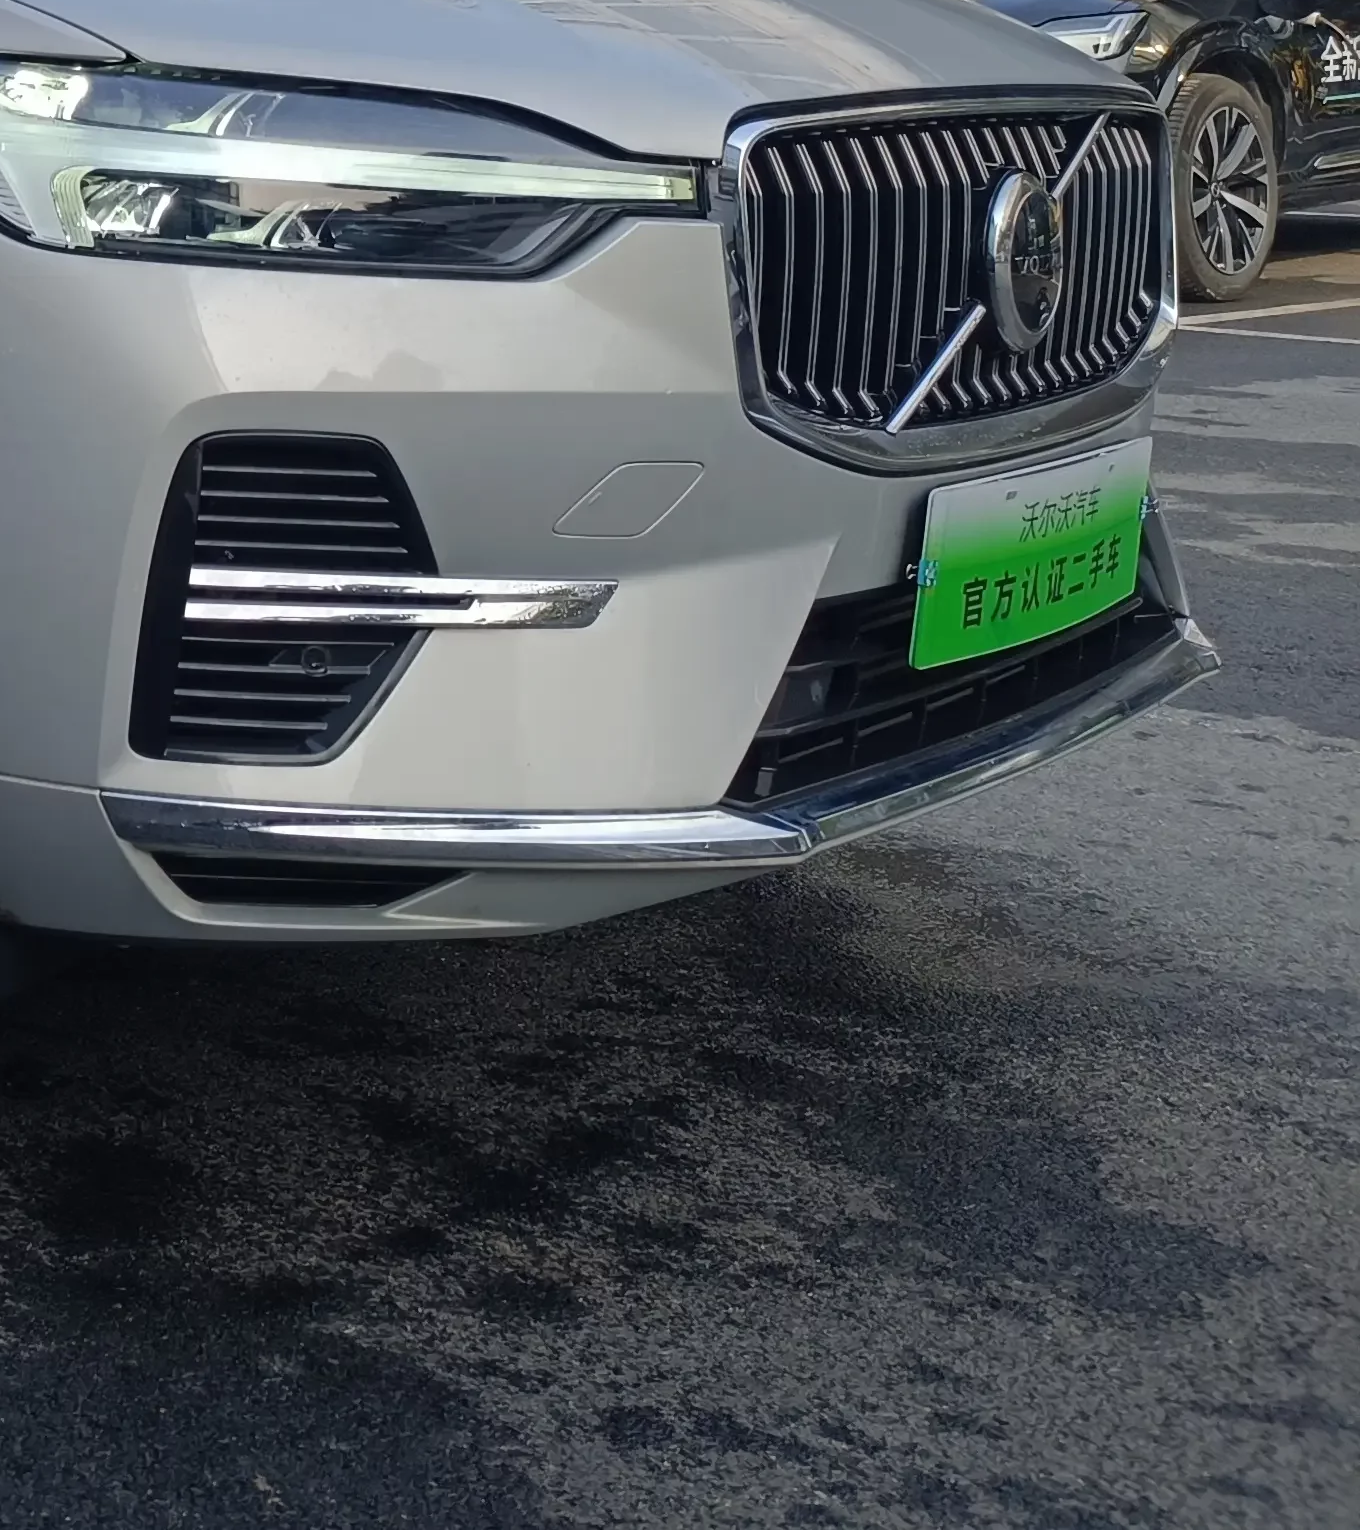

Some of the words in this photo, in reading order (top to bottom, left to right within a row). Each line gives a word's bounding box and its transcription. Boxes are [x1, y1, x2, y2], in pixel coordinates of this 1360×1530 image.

[1018, 483, 1102, 543] 沃尔沃汽车
[961, 533, 1123, 630] 官方认证二手车
